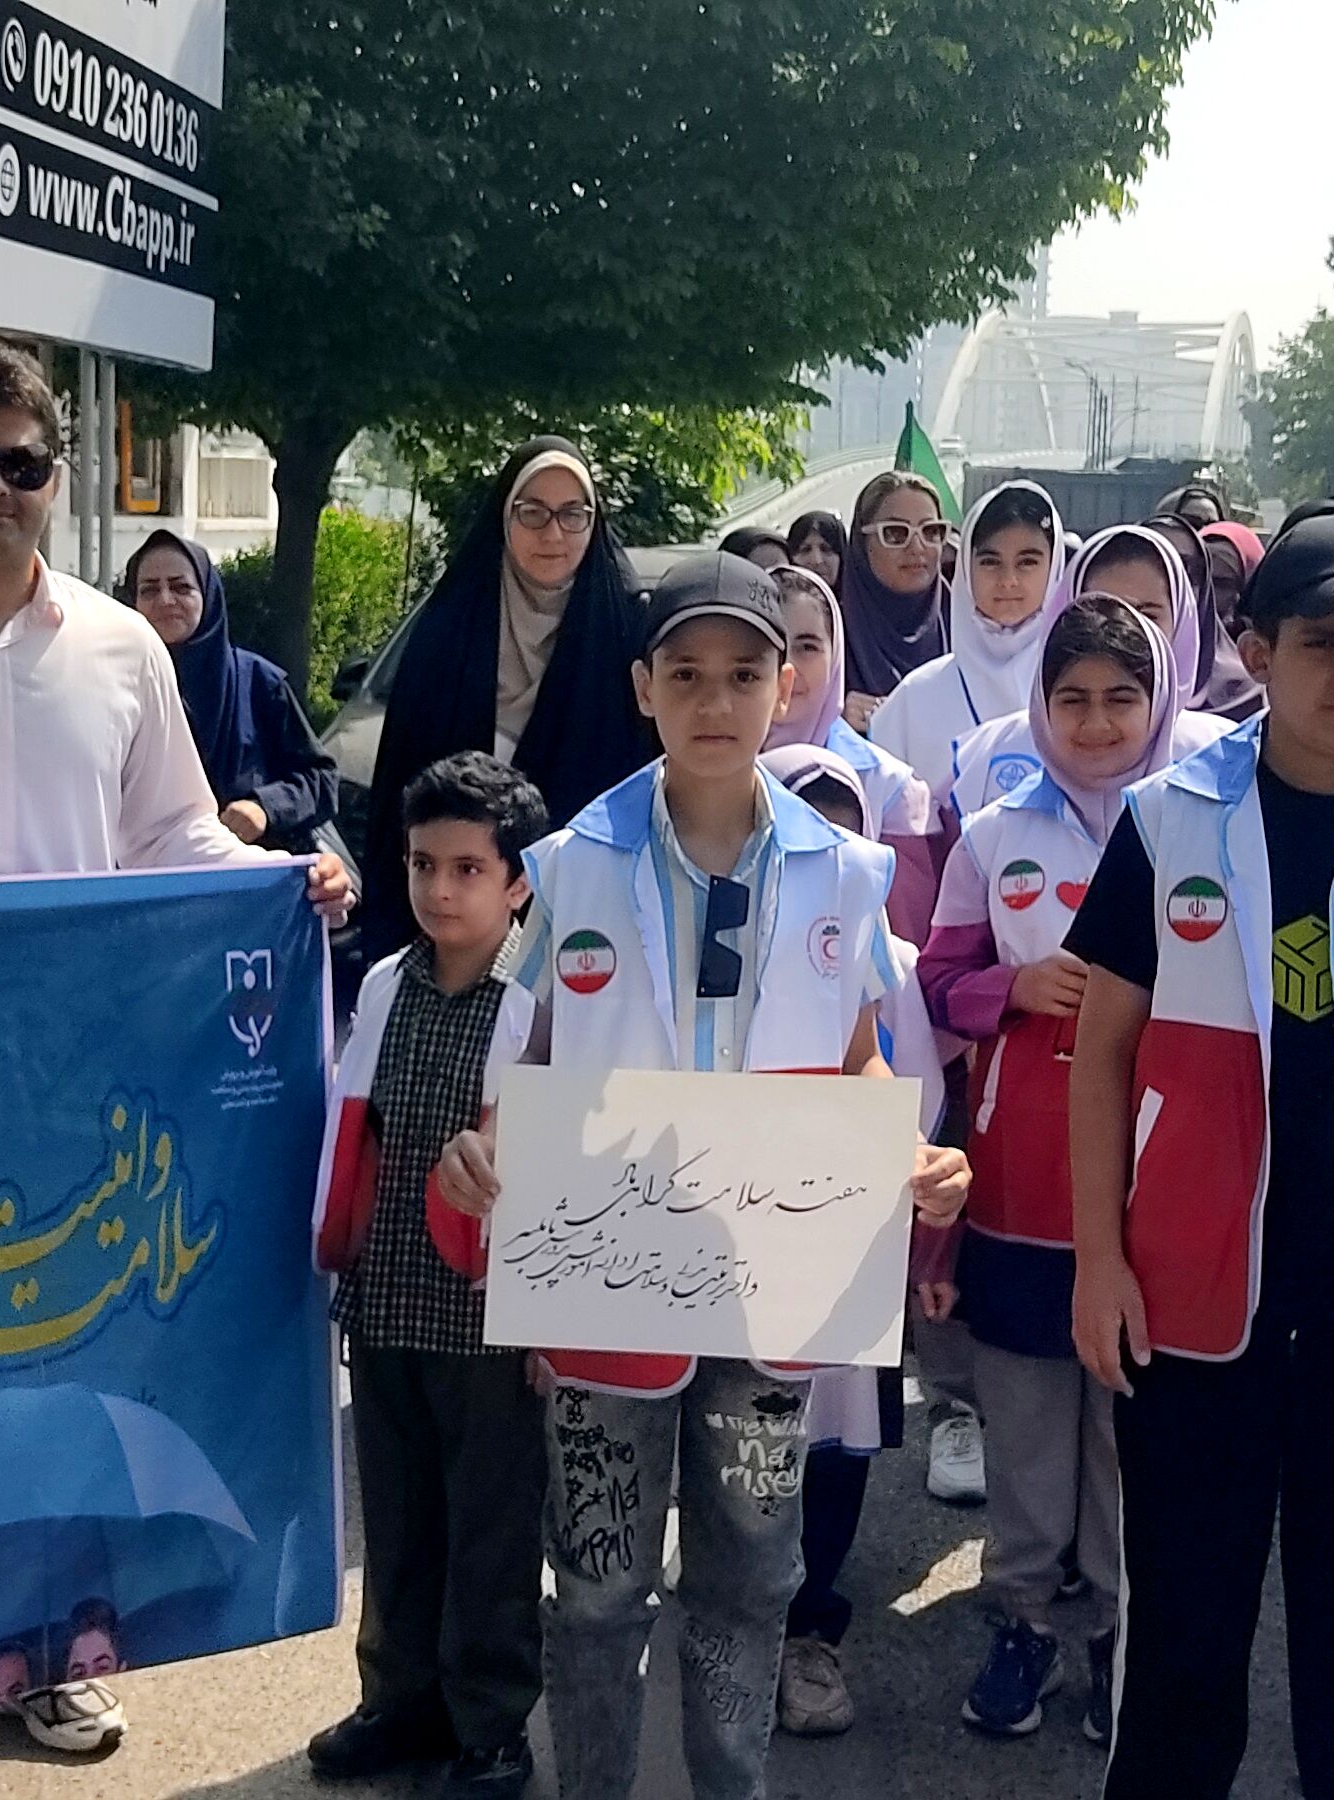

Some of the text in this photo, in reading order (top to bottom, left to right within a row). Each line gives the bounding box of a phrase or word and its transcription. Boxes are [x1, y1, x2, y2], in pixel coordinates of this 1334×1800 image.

[33, 31, 199, 172] 0910 236 0136
[28, 163, 195, 272] www.Cbapp.ir
